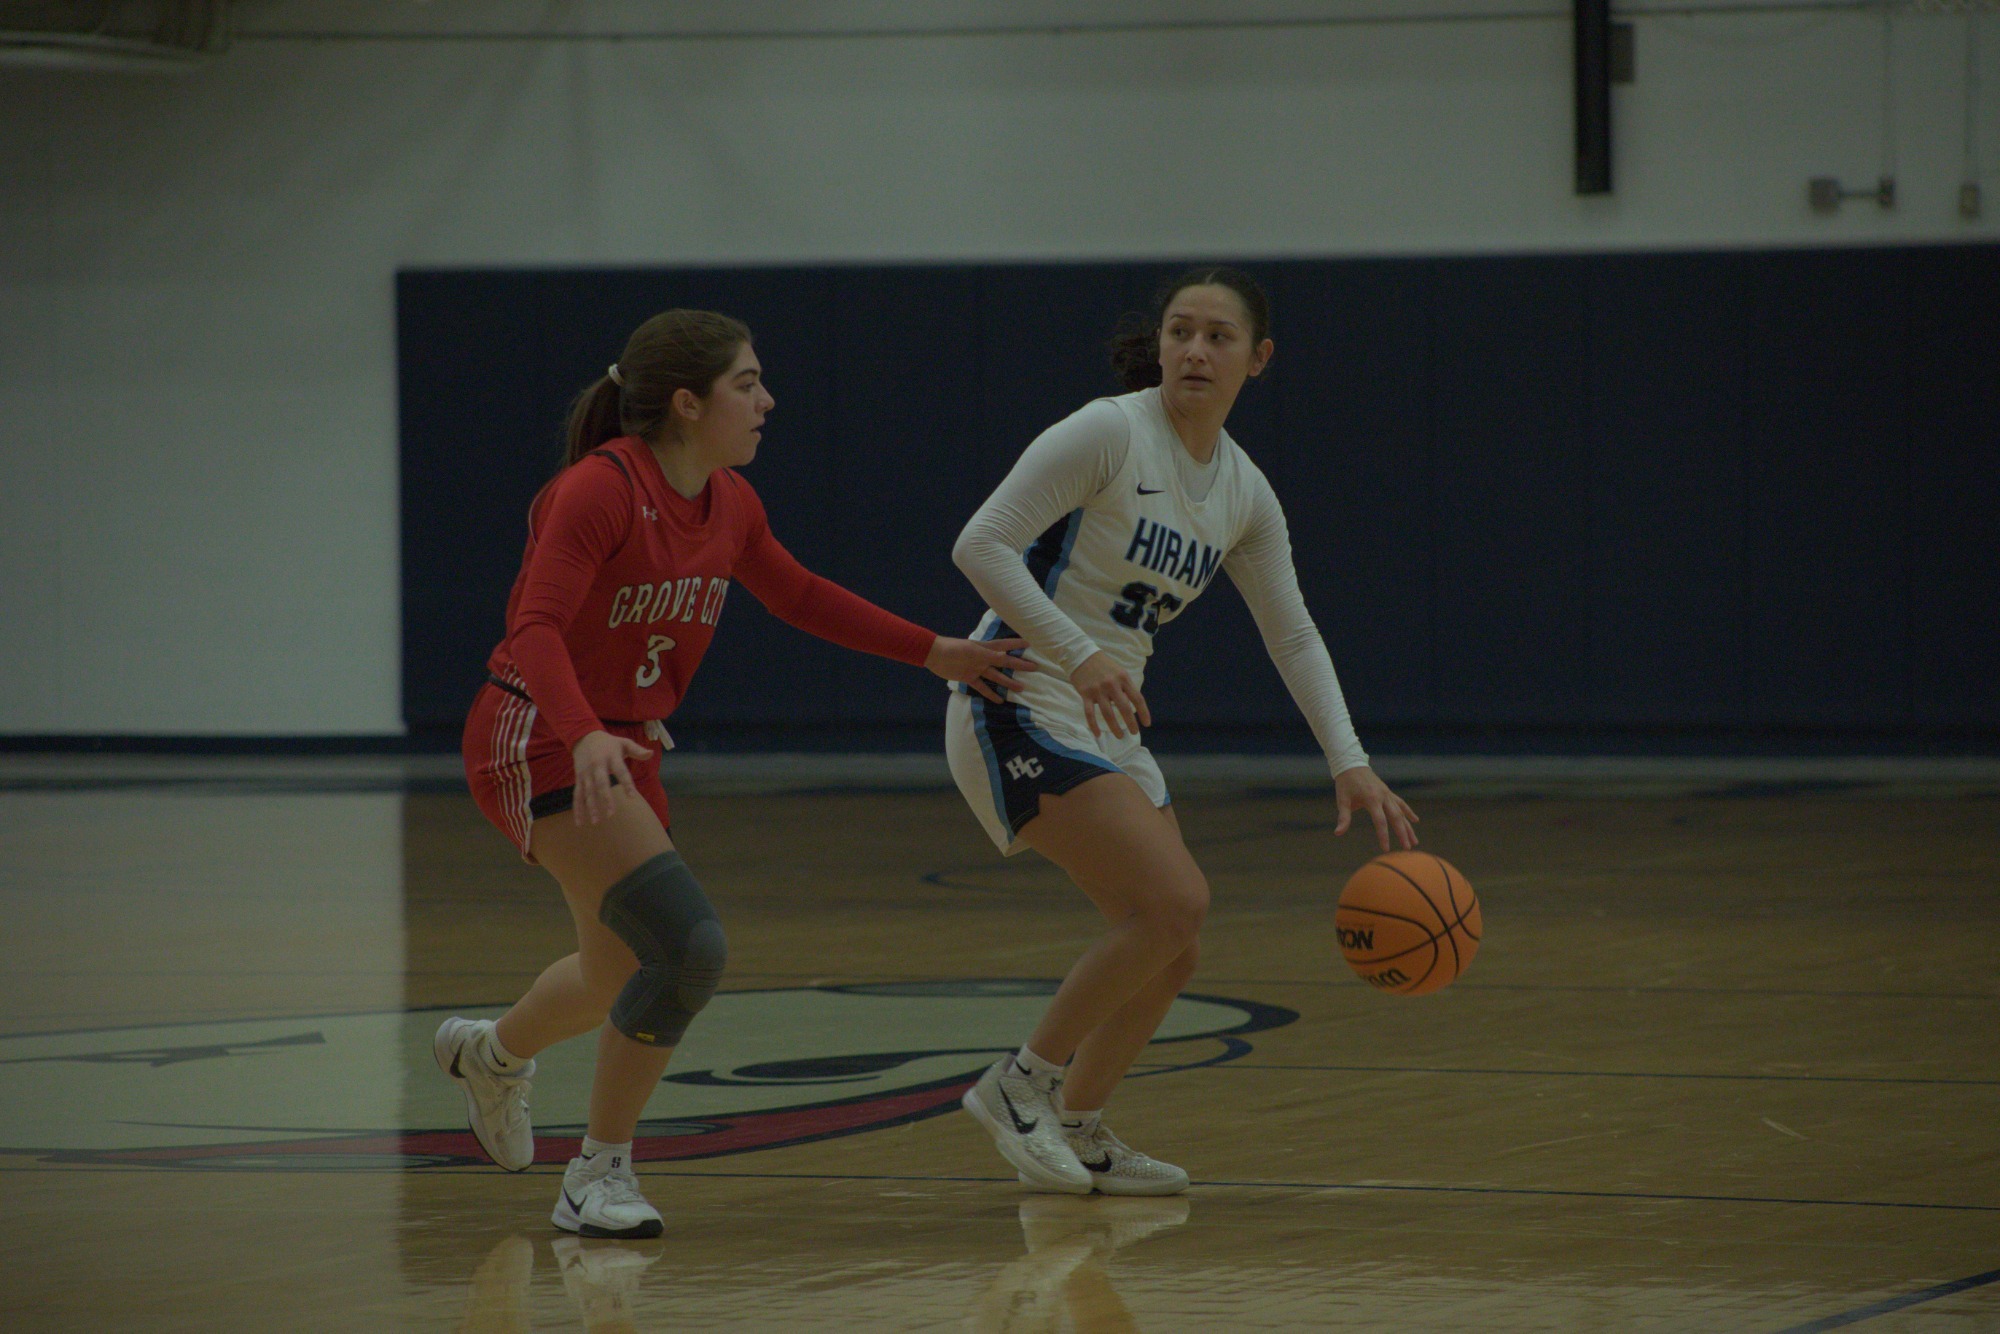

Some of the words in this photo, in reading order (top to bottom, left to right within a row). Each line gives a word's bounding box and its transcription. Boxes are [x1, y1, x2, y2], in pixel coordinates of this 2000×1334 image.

[1124, 516, 1222, 589] HIRAM
[608, 576, 702, 629] GROVE
[636, 634, 677, 688] 3
[1005, 755, 1045, 780] HC
